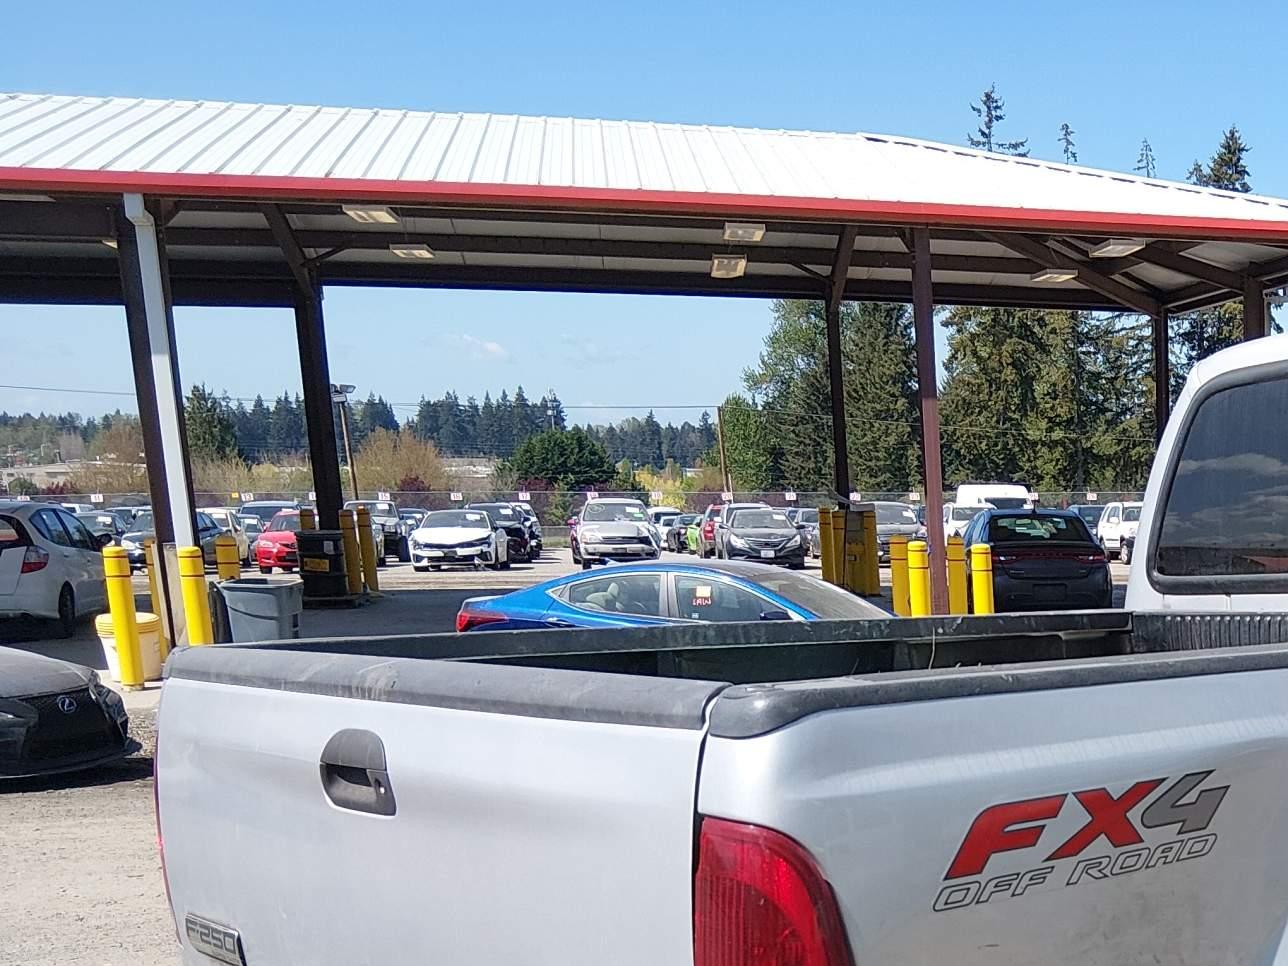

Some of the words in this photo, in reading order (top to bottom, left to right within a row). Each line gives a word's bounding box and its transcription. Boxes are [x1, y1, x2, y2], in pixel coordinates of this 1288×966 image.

[932, 865, 1056, 912] OFF
[1066, 833, 1218, 886] ROAD
[942, 768, 1231, 881] FX4
